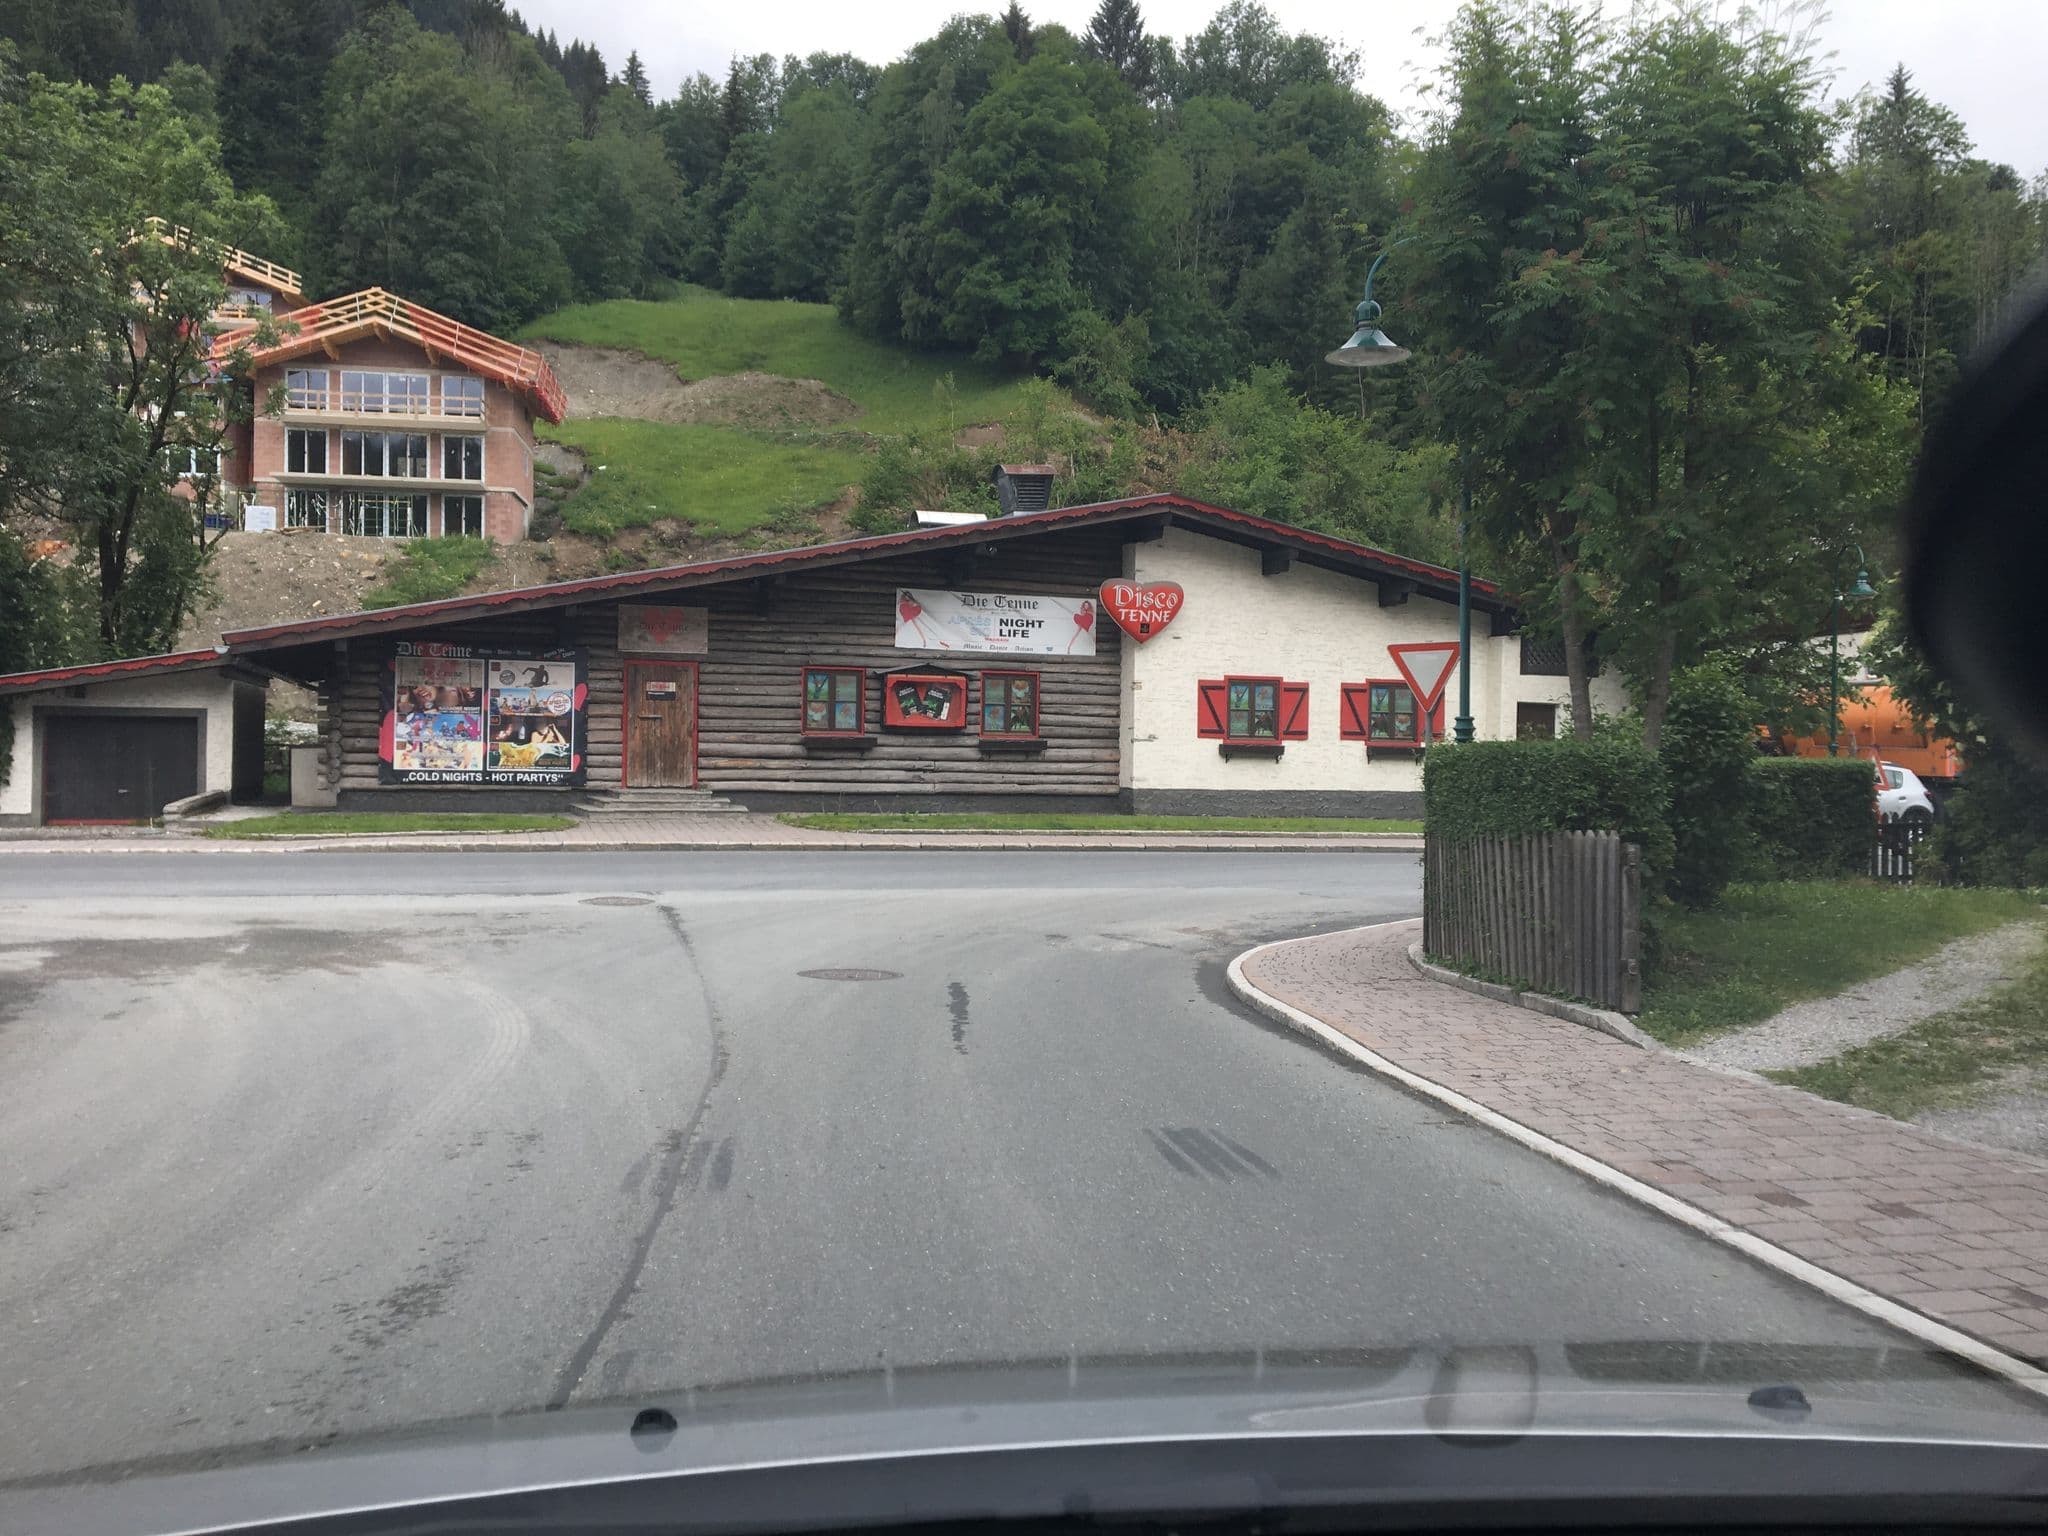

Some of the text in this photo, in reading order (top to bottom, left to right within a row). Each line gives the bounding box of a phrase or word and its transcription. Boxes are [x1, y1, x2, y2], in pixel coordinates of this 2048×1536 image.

[961, 594, 1039, 610] Die Tenne
[1112, 584, 1179, 609] Disco
[1118, 609, 1172, 622] TENNE
[999, 618, 1045, 629] NIGHT
[999, 629, 1030, 639] LIFE
[396, 641, 423, 656] Die
[429, 642, 472, 658] Tenne
[442, 772, 483, 782] NIGHTS
[491, 773, 516, 782] HOT
